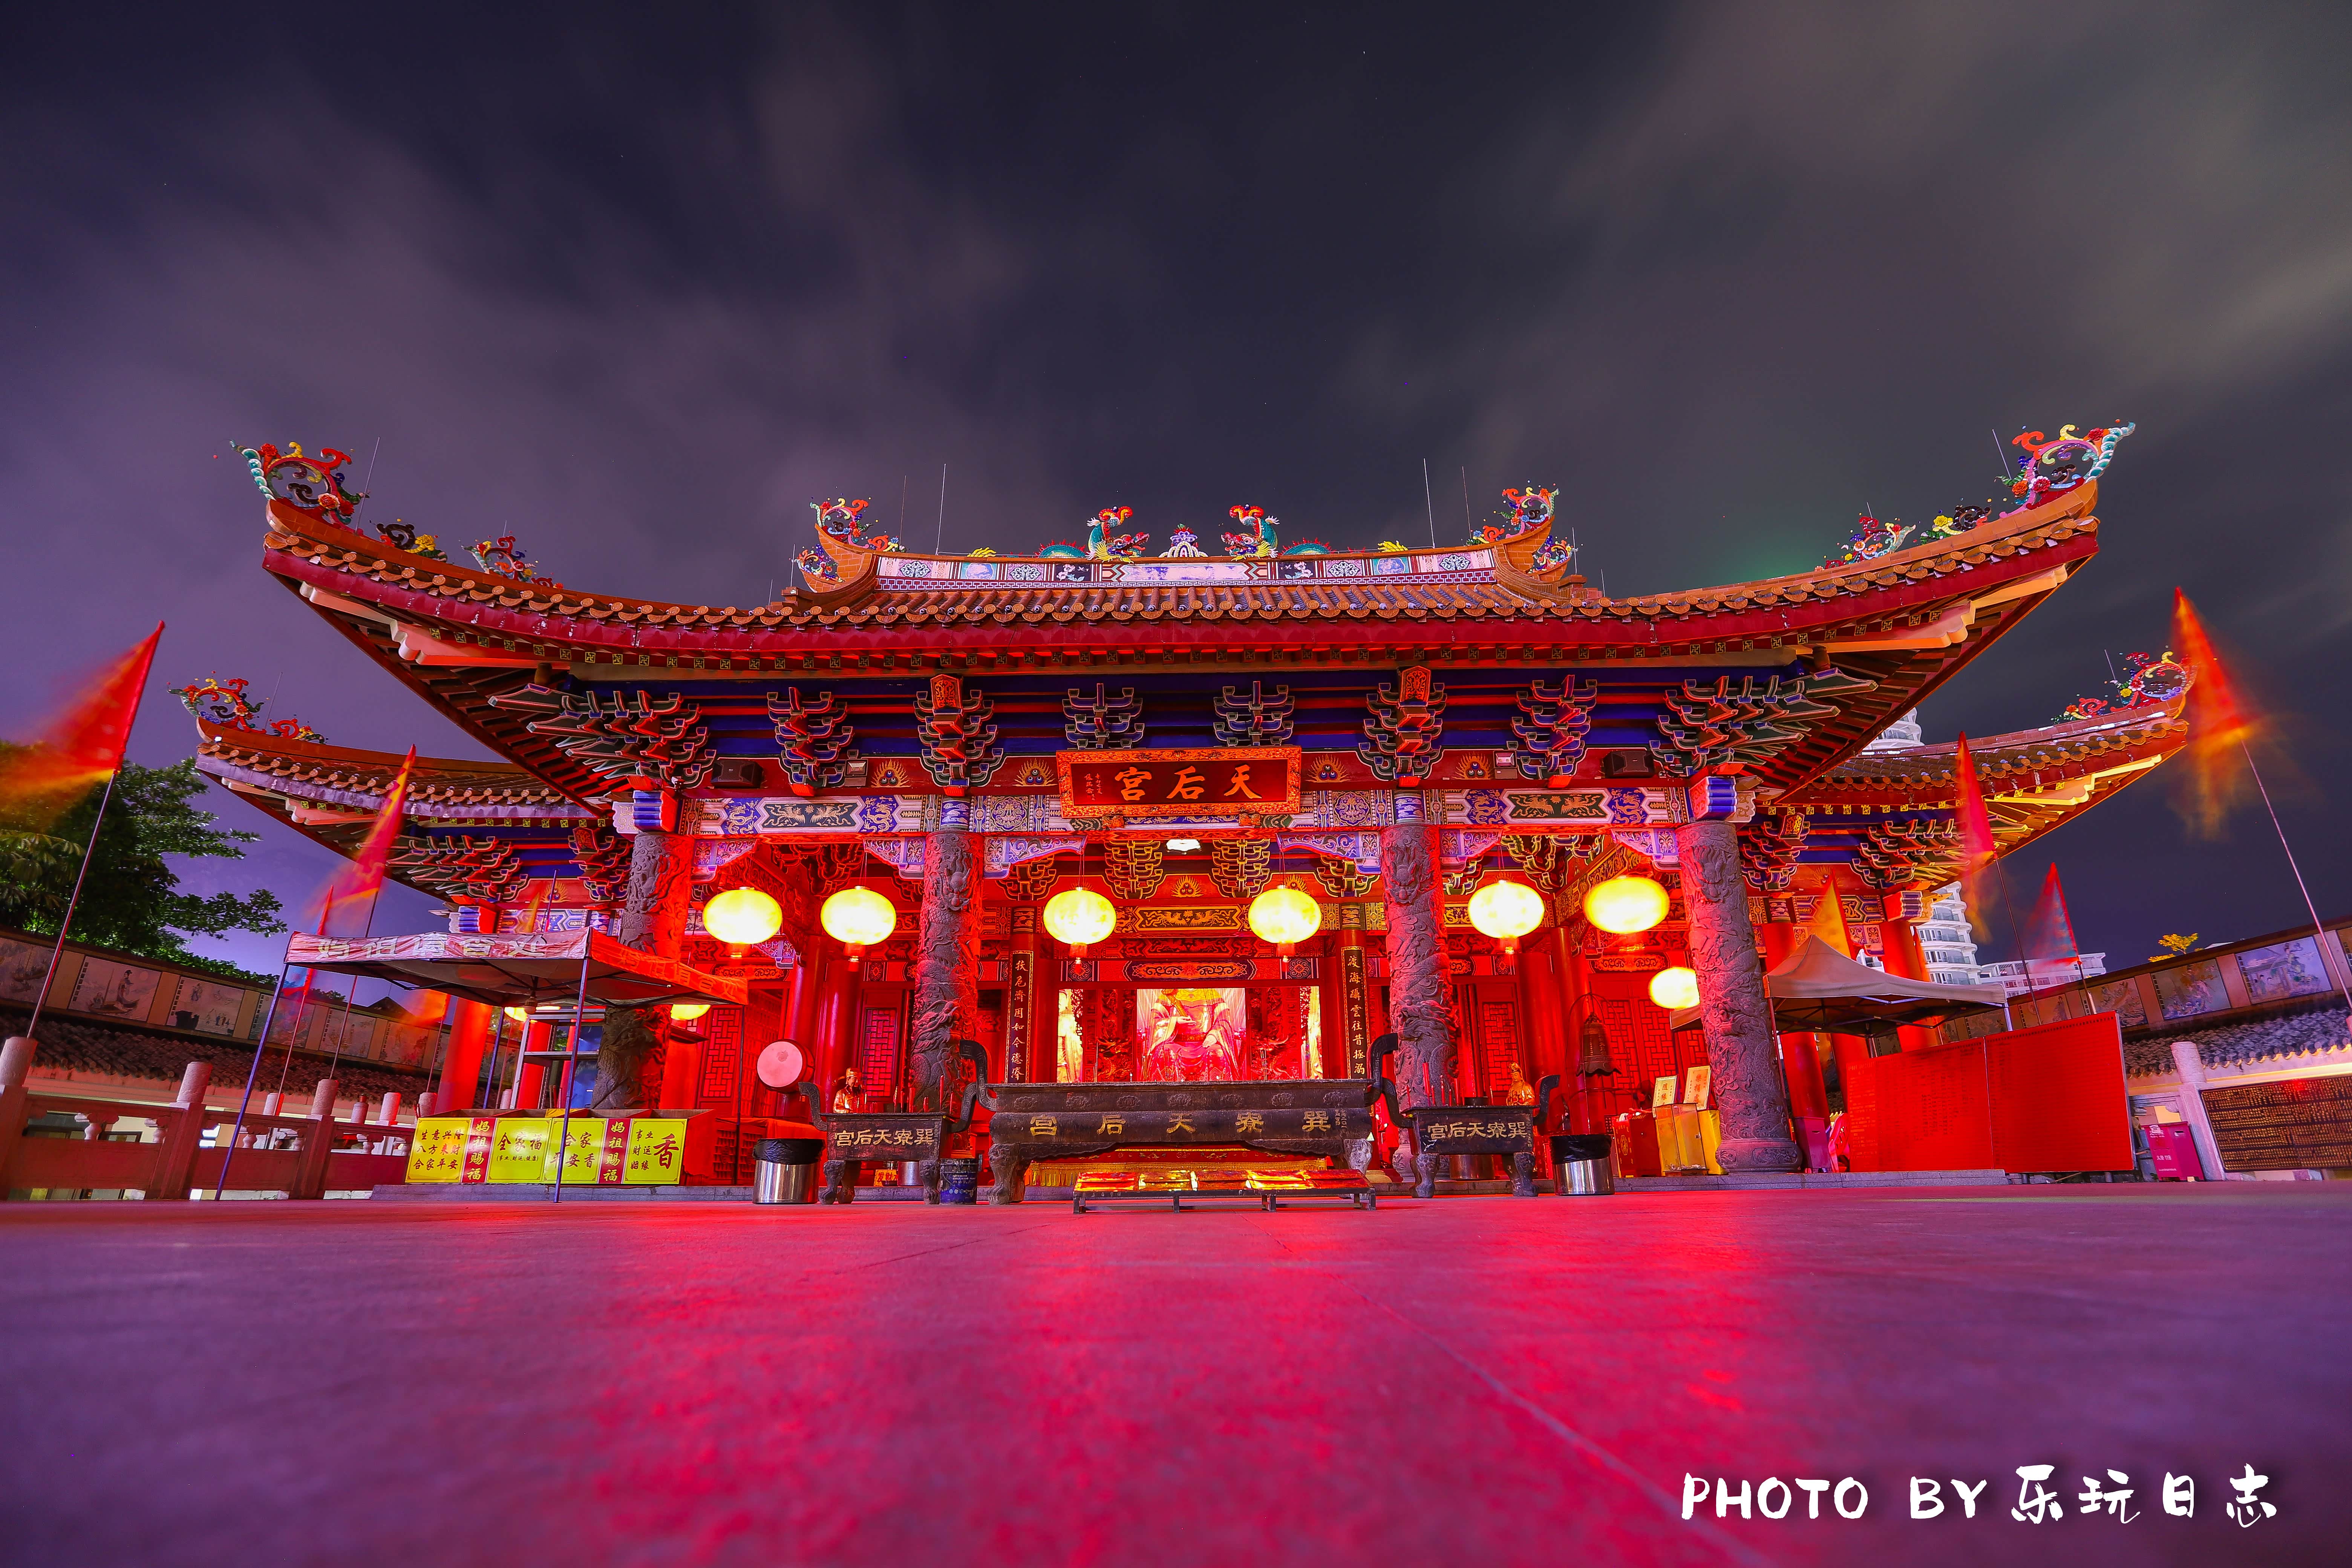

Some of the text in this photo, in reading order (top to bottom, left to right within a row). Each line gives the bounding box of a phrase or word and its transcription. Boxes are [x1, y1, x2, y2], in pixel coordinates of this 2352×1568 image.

[1115, 765, 1262, 801] 天后宫
[421, 1129, 464, 1140] 生意兴隆
[498, 1132, 542, 1152] 全家福
[565, 1132, 591, 1148] 合家
[636, 1129, 654, 1141] 事业
[417, 1144, 461, 1155] 八方来财
[467, 1120, 490, 1180] 妈祖赐福
[603, 1121, 625, 1181] 妈祖赐福
[632, 1144, 652, 1156] 财运
[653, 1133, 680, 1169] 香
[413, 1158, 458, 1170] 合家平安
[550, 1152, 595, 1168] 平安香
[631, 1160, 649, 1171] 姻缘
